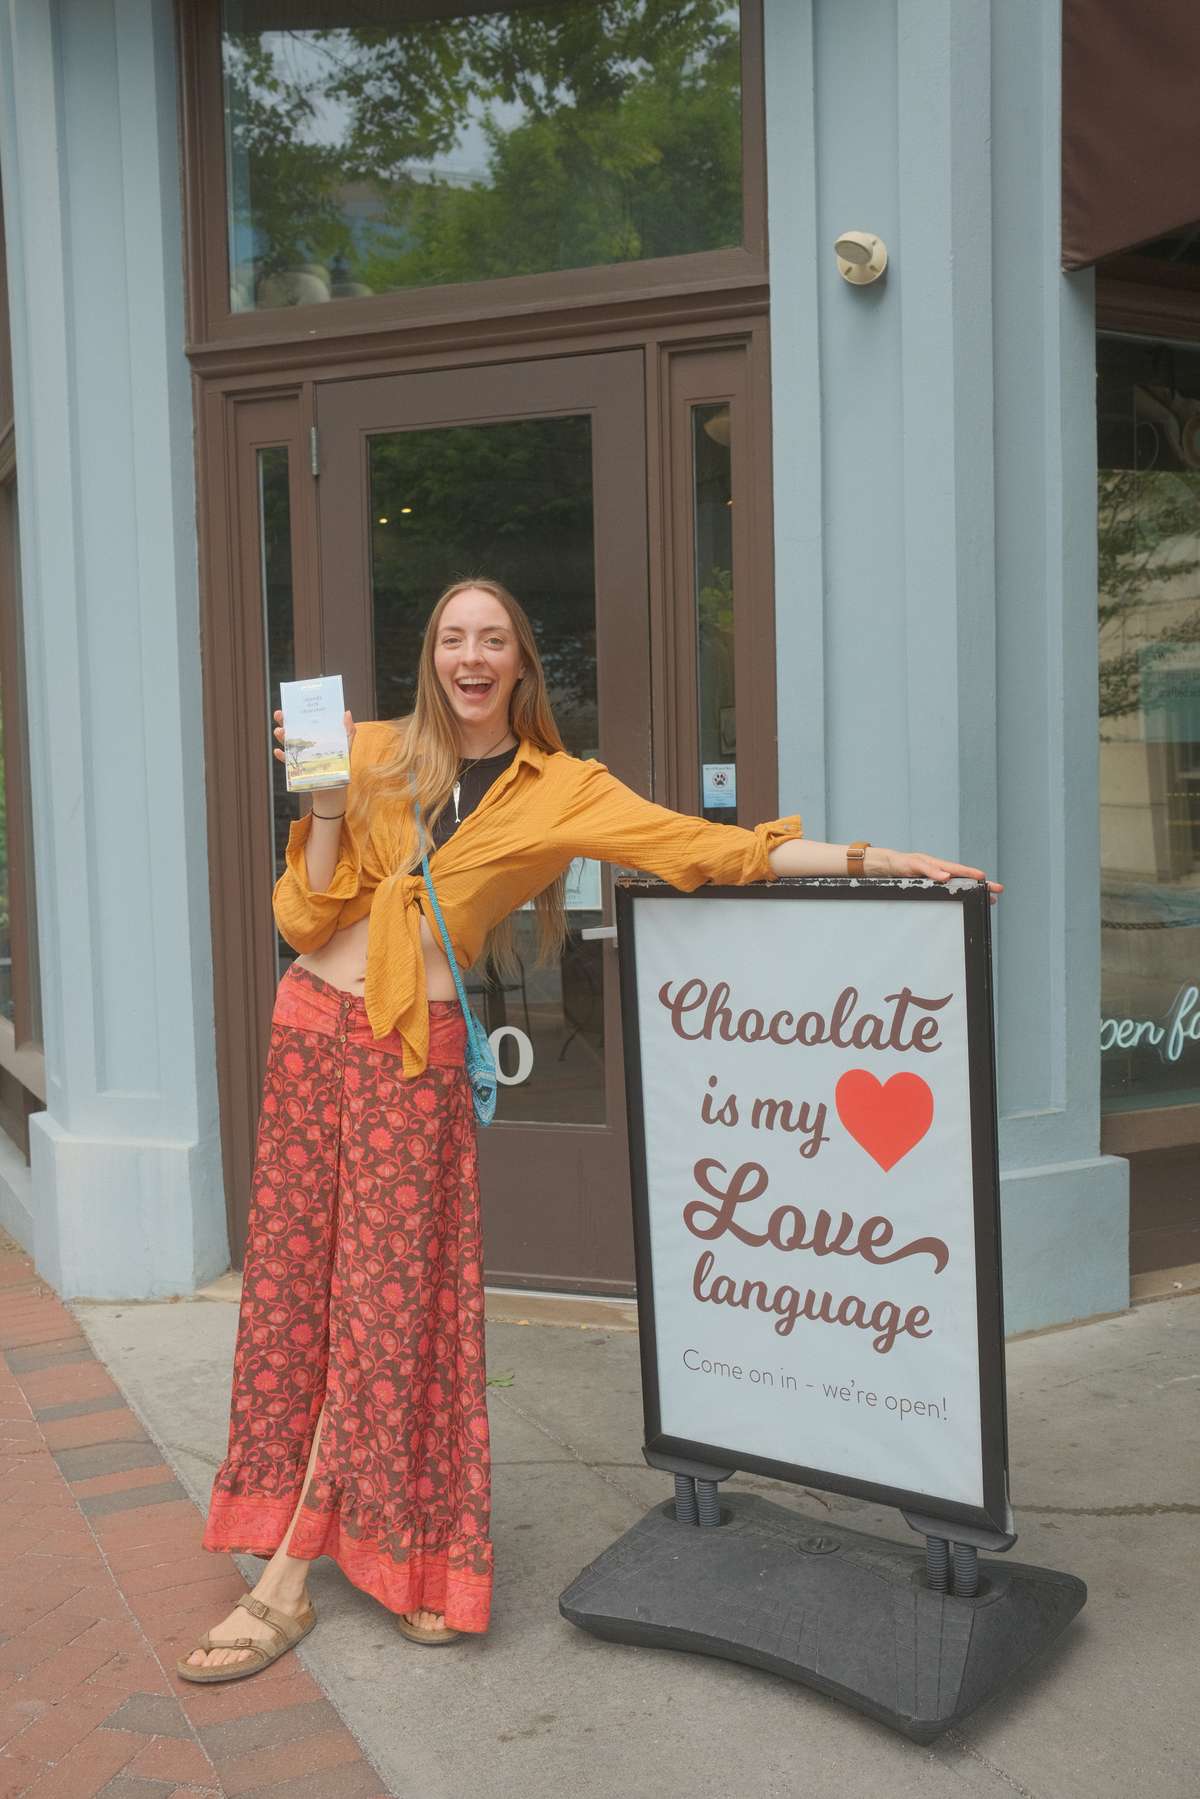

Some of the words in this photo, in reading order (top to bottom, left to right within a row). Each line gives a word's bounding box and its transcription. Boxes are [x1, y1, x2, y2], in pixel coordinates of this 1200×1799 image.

[658, 978, 954, 1054] Chocolate
[1100, 1018, 1165, 1051] pen
[701, 1075, 739, 1127] is
[751, 1098, 830, 1159] my
[683, 1157, 950, 1275] Love
[692, 1250, 934, 1355] language
[683, 1348, 743, 1380] Come
[749, 1369, 774, 1386] on
[781, 1368, 798, 1391] in
[823, 1379, 878, 1407] we're
[885, 1396, 948, 1422] open!
